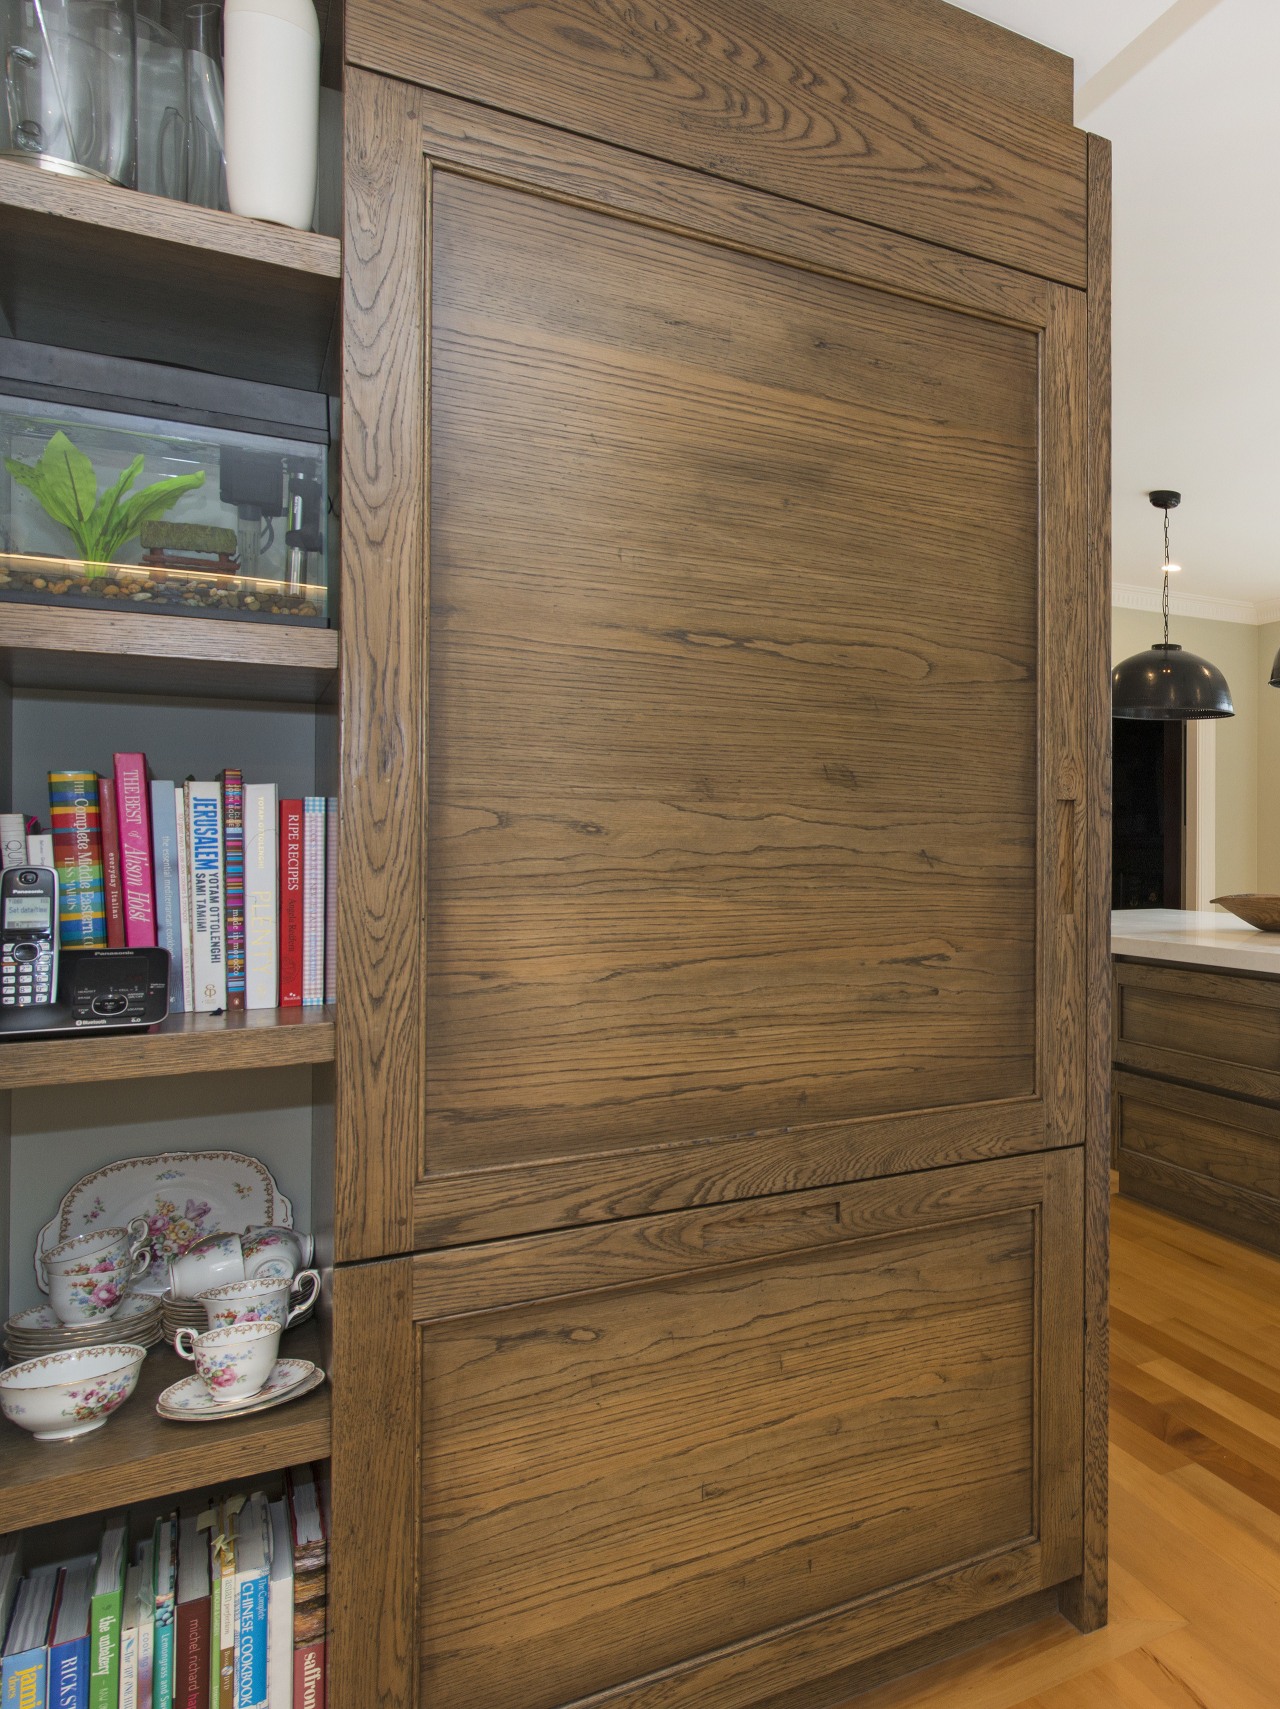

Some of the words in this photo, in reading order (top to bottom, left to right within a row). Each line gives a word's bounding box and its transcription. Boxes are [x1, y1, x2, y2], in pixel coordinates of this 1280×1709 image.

[74, 781, 84, 796] THE
[123, 770, 140, 793] THE
[74, 798, 90, 849] Complete
[125, 796, 141, 824] BEST
[288, 815, 299, 840] RIPE
[162, 836, 170, 847] the
[193, 797, 219, 870] JERUSALEM
[65, 856, 76, 878] TESS
[78, 852, 93, 889] Middle
[108, 852, 118, 888] everyday
[124, 844, 149, 886] Alison
[163, 849, 172, 878] essential
[287, 844, 299, 891] RECIPES
[196, 873, 206, 896] SAMI
[209, 873, 219, 903] YOTAM
[80, 891, 95, 934] Eastern
[110, 891, 119, 919] Italian
[127, 889, 151, 923] Holst
[164, 879, 173, 926] mediterranean
[196, 900, 207, 933] TAMIMI
[232, 910, 240, 930] made
[209, 907, 220, 964] OTTOLENGHI
[251, 891, 272, 975] PLENTY
[232, 942, 241, 976] morocco
[242, 1583, 254, 1634] CHINESE
[256, 1591, 266, 1620] Complete
[99, 1616, 116, 1632] the
[189, 1618, 201, 1654] michel
[92, 1634, 116, 1677] unbakery
[139, 1632, 150, 1668] cooking
[159, 1633, 170, 1678] Lemongrass
[60, 1656, 78, 1696] RICK
[160, 1680, 169, 1694] and
[188, 1656, 200, 1691] richard
[241, 1636, 253, 1706] COOKBOOK
[304, 1652, 321, 1709] saffron
